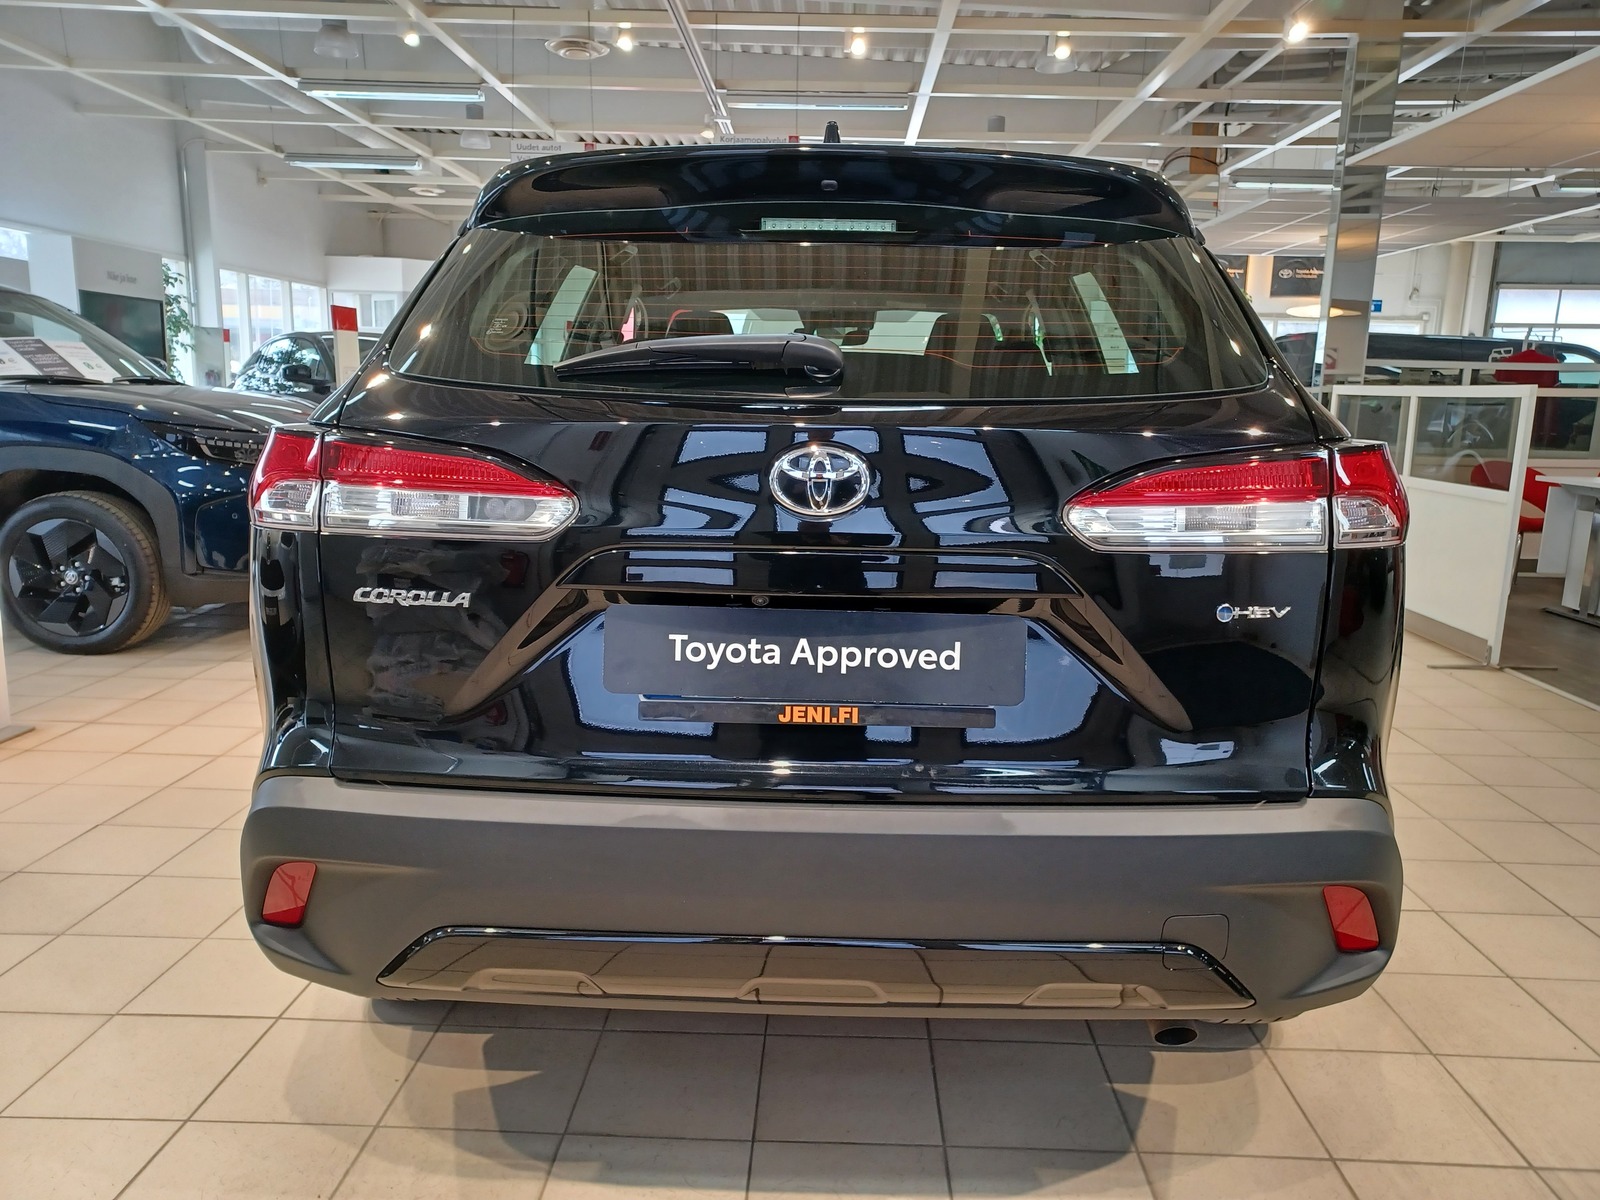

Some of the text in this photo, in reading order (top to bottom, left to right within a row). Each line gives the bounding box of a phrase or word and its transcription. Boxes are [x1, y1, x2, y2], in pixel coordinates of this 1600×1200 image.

[516, 143, 562, 152] Uudet autot
[352, 586, 472, 608] COROLLA
[668, 633, 962, 674] Toyota Approved
[777, 705, 860, 724] JENI.FI
